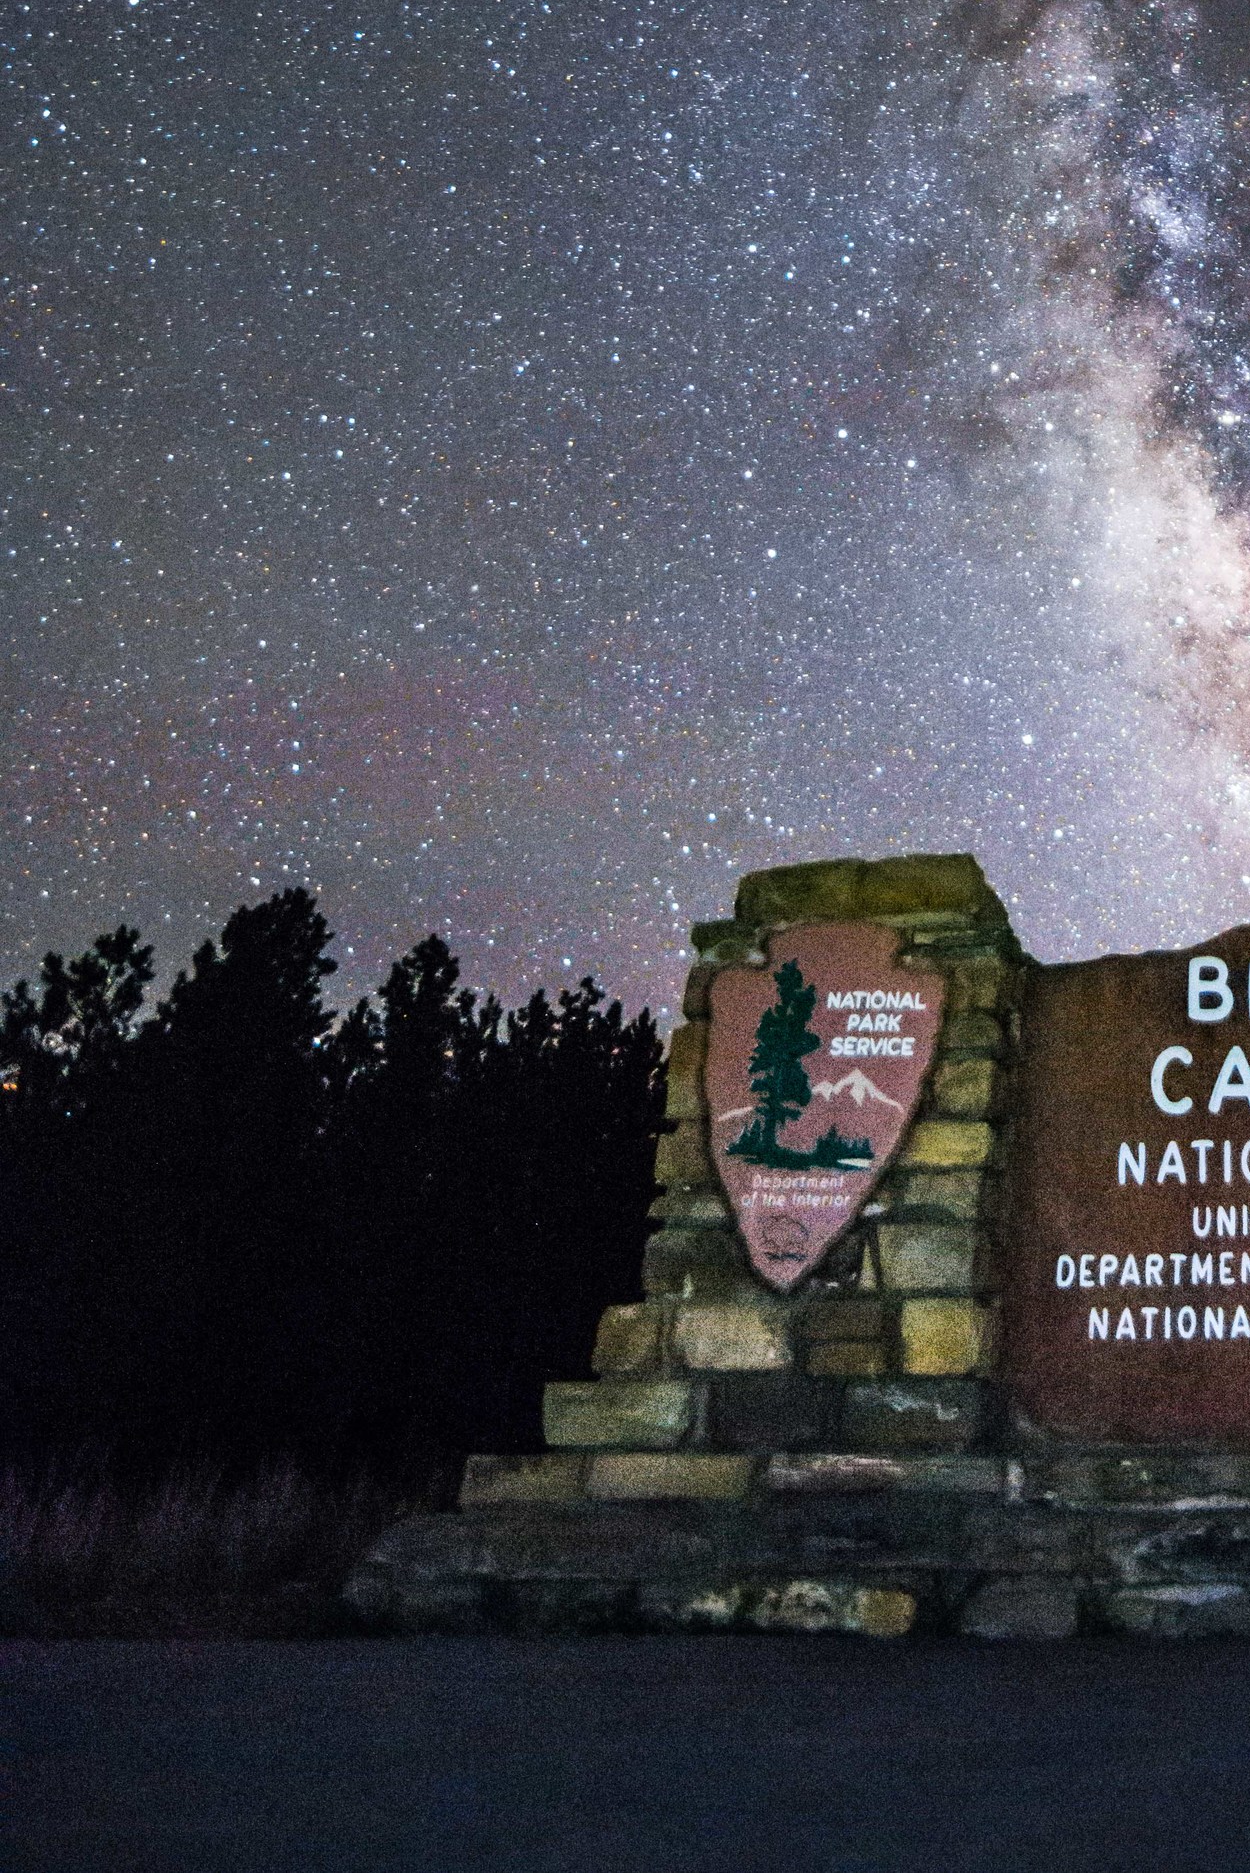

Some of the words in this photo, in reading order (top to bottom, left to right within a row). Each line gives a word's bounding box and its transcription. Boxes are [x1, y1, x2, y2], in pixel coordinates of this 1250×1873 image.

[827, 990, 926, 1010] NATIONAL
[847, 1013, 902, 1032] PARK
[830, 1036, 915, 1057] SERVICE
